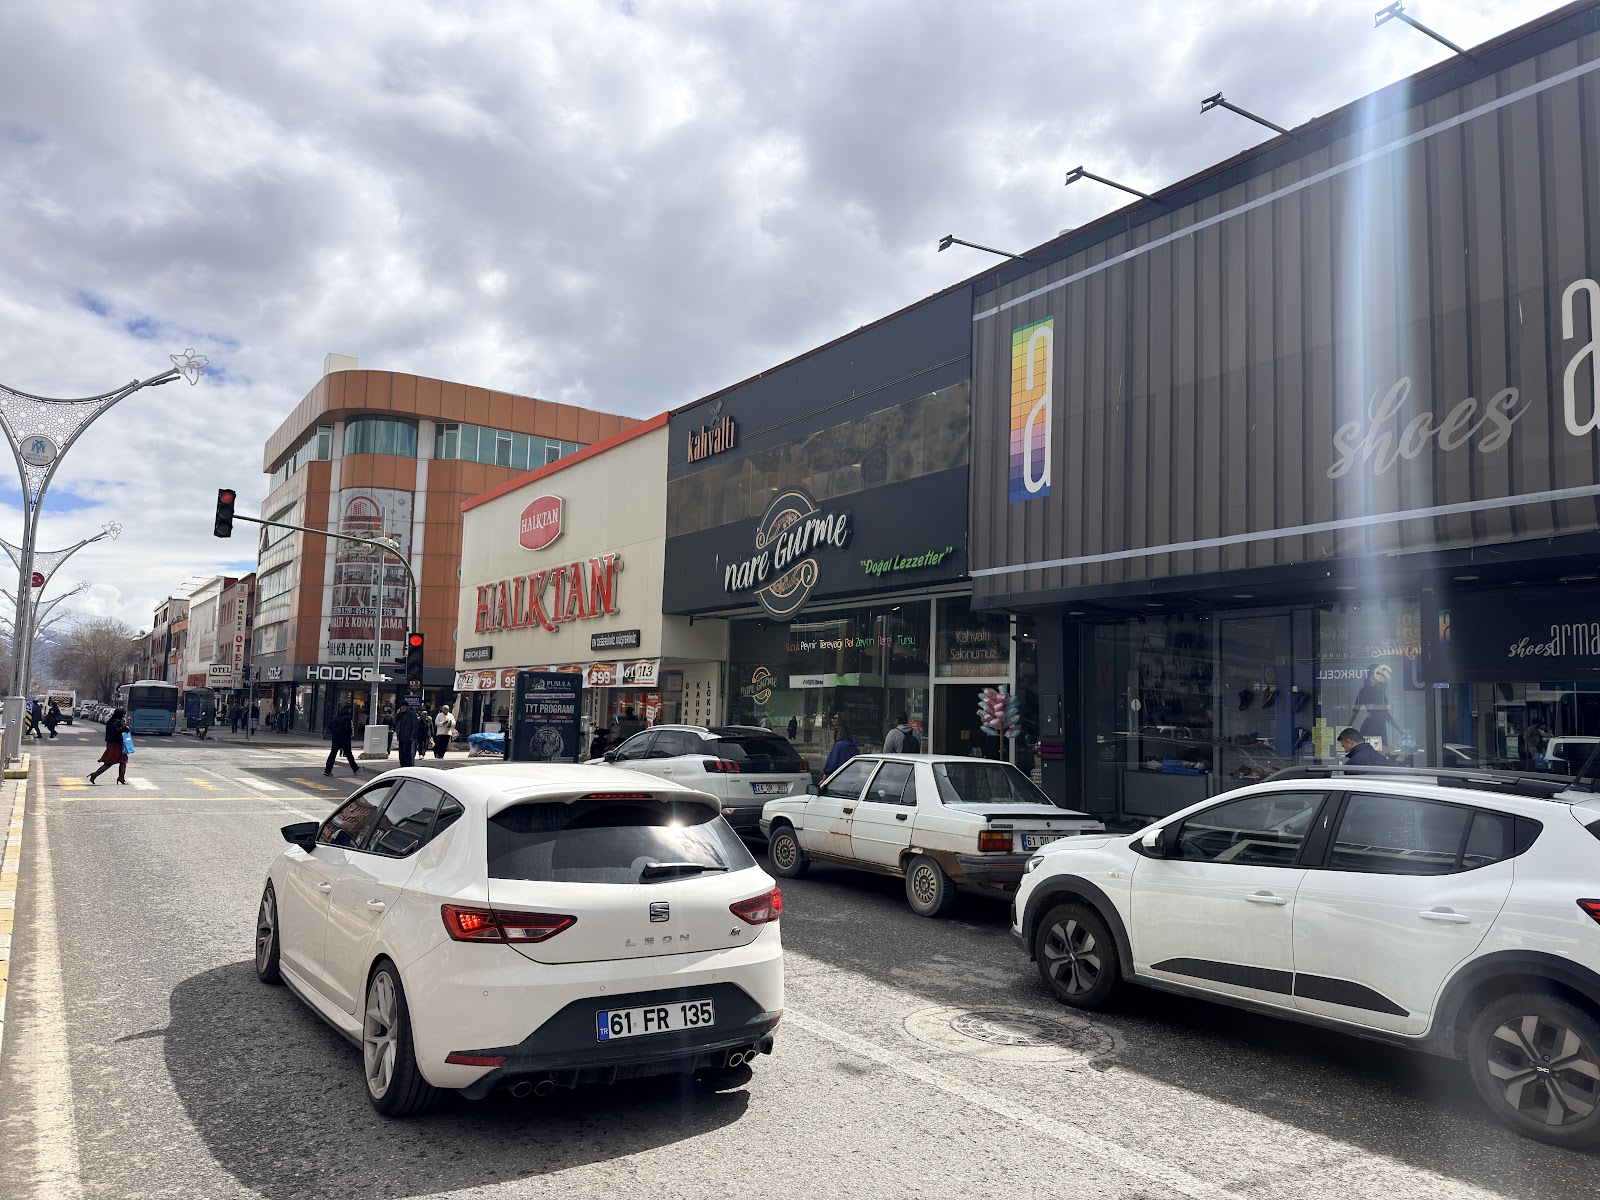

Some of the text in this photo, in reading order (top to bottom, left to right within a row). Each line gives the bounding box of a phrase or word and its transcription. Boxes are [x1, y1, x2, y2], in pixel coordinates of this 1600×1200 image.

[1326, 376, 1532, 480] shoes
[521, 508, 559, 533] HALKTAN
[724, 513, 848, 592] nare Gurme
[475, 552, 619, 633] HALKTAN
[351, 616, 403, 629] KONALAMA
[234, 635, 243, 671] OTEL
[348, 642, 391, 661] AÇIKIR
[801, 640, 818, 652] Peynir
[1508, 636, 1552, 658] shoes
[212, 666, 232, 674] OTEL
[624, 666, 635, 678] 61
[481, 677, 492, 688] 79
[525, 703, 575, 714] TYT PROGRAMI
[1027, 836, 1034, 846] 61
[625, 933, 690, 948] LEON
[610, 1011, 632, 1036] 61
[643, 1007, 670, 1032] FR
[680, 1002, 712, 1027] 135
